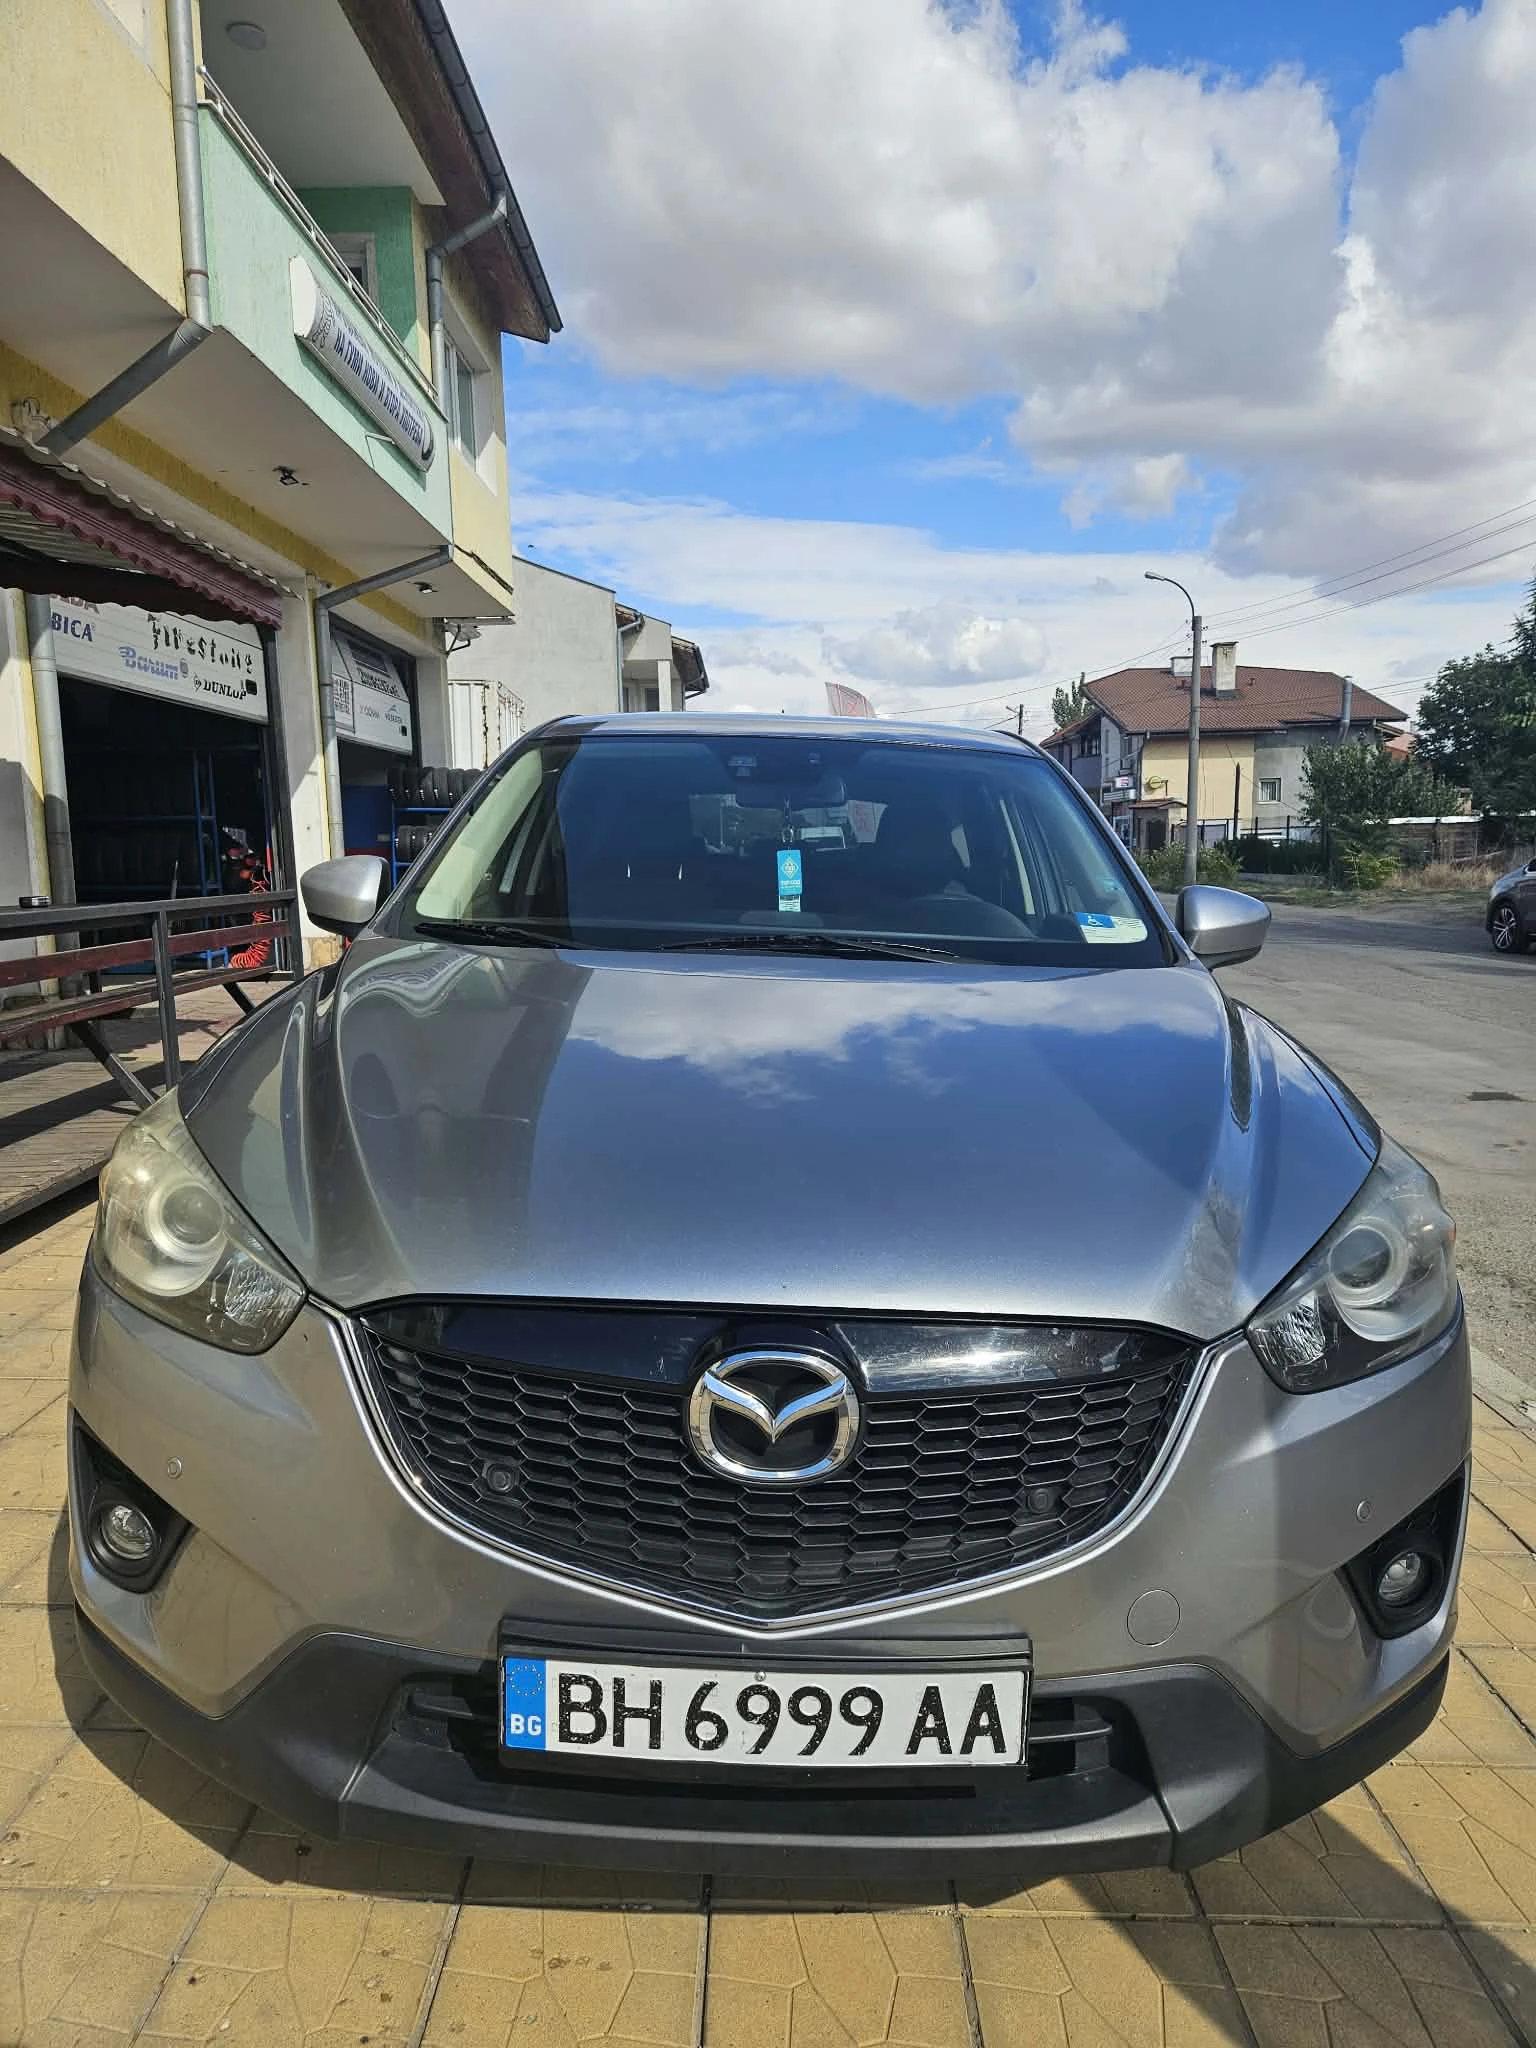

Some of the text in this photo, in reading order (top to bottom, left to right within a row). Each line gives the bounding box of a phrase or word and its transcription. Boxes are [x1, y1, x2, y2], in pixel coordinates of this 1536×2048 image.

[333, 328, 346, 356] НА
[344, 340, 363, 377] ГУМИ
[361, 360, 379, 395] НОВИ
[383, 385, 401, 420] ВТОРА
[203, 679, 246, 700] DUNLOP
[510, 1714, 542, 1737] BG
[558, 1672, 1007, 1756] BH 6999 AA
